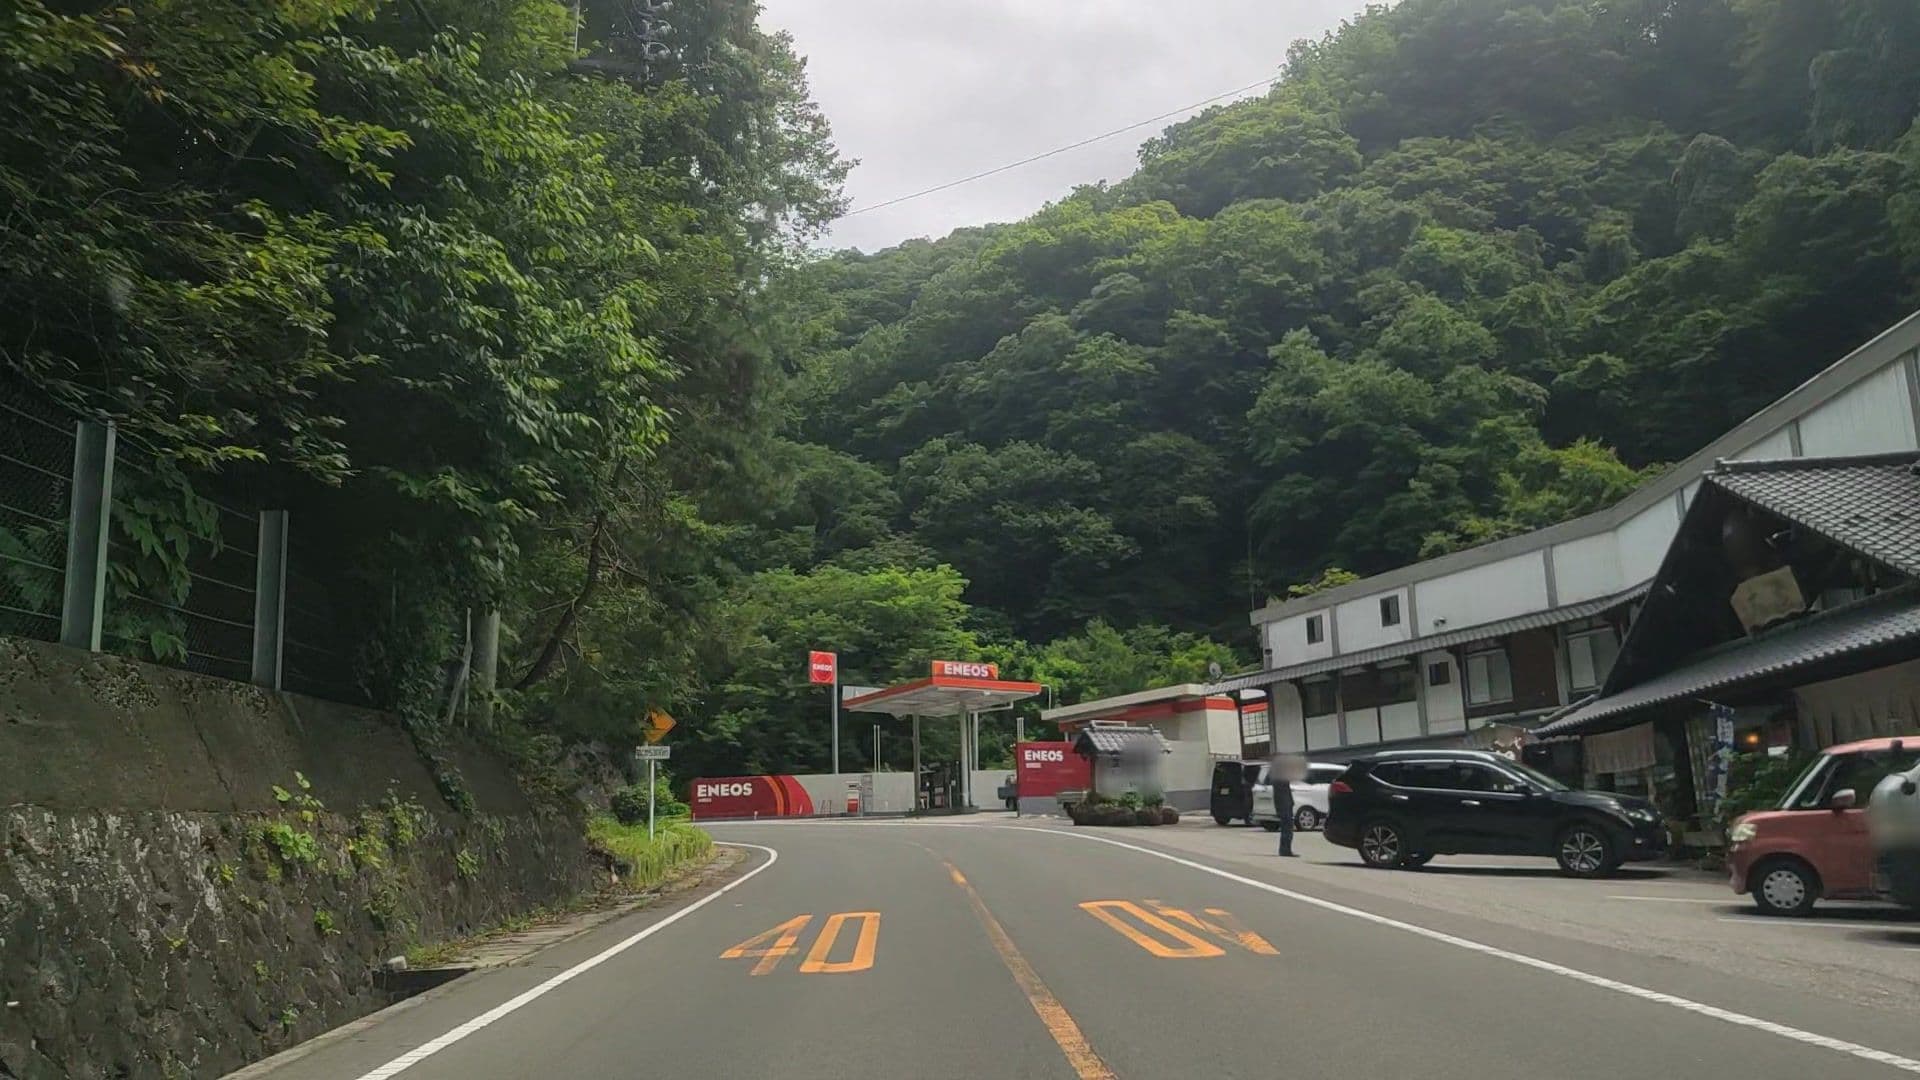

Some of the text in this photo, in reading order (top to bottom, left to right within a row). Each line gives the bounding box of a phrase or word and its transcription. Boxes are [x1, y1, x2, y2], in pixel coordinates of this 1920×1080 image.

[944, 663, 989, 678] ENEOS
[1024, 749, 1064, 762] ENEOS
[697, 782, 753, 797] ENEOS
[720, 912, 881, 976] 40
